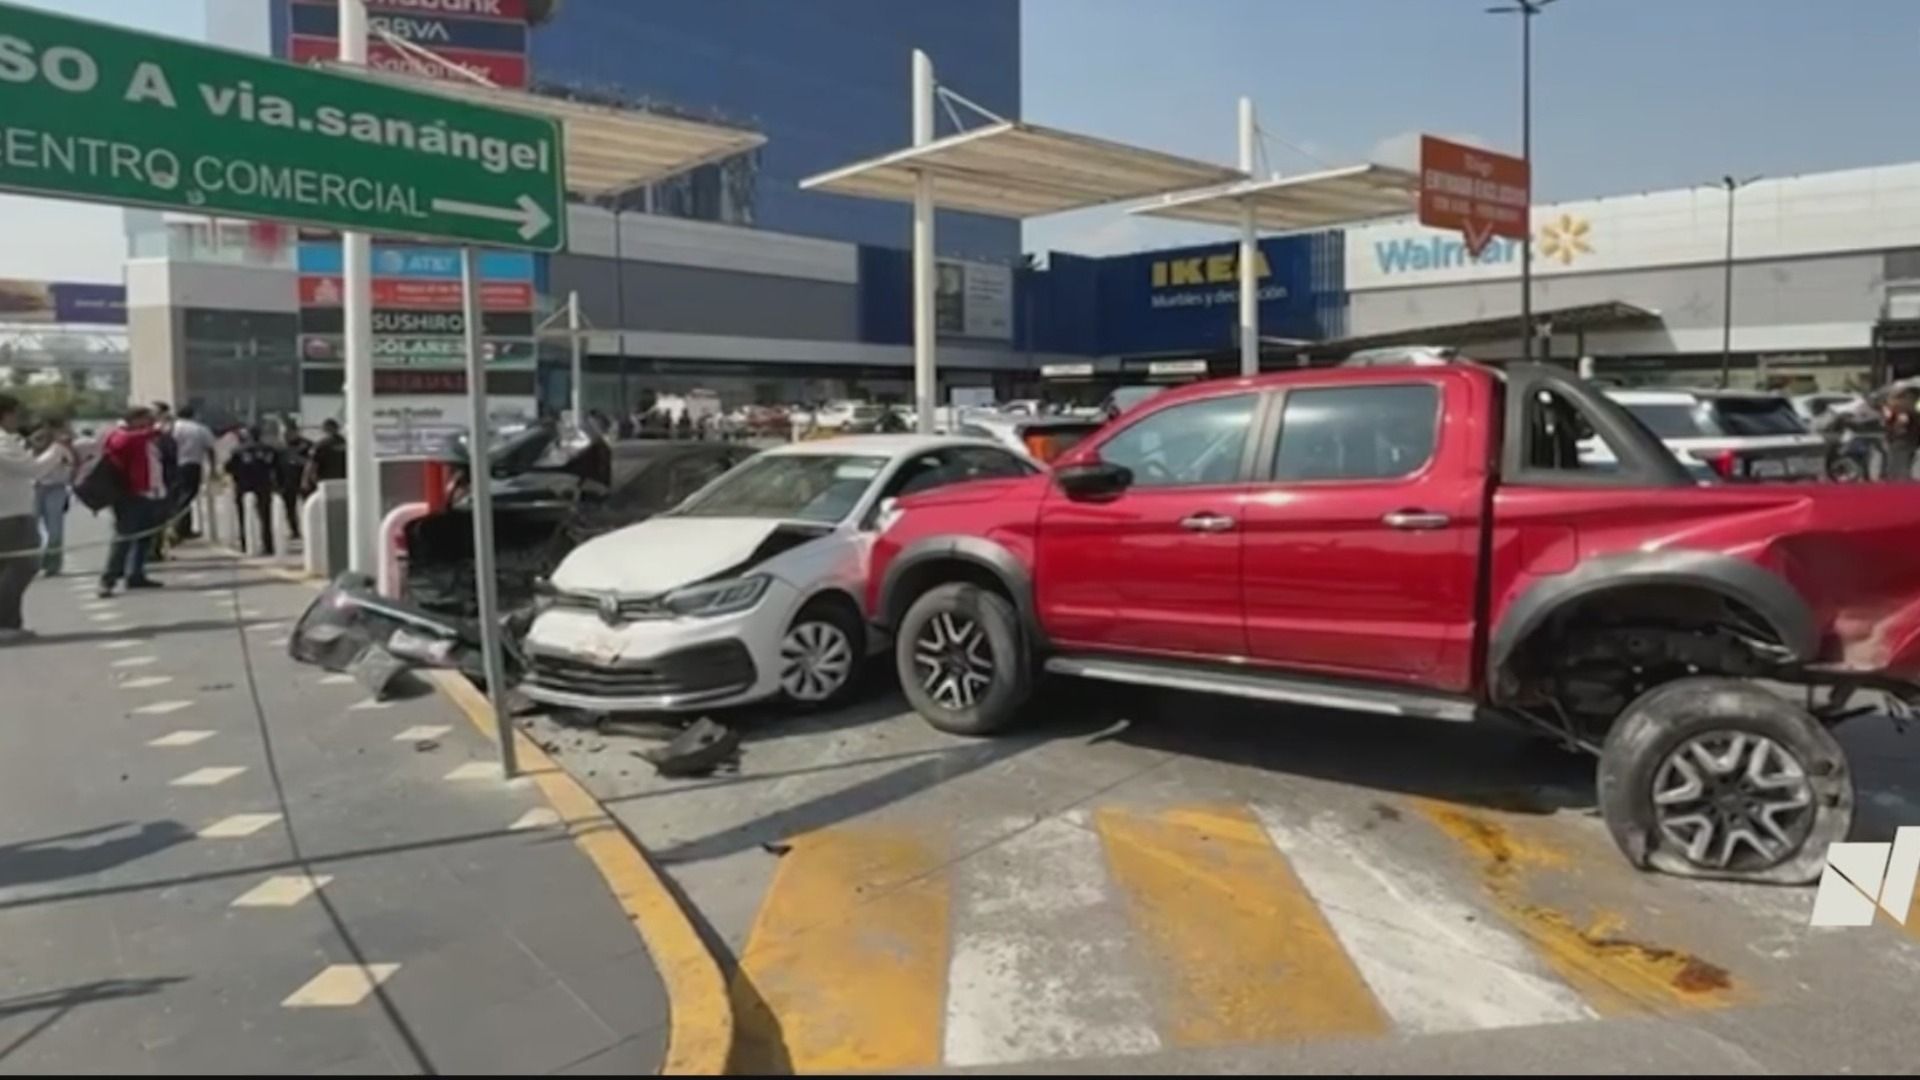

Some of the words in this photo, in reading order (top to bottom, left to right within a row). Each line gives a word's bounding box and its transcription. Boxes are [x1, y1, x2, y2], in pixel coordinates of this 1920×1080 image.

[124, 61, 177, 109] A
[0, 126, 180, 190] ENTRO
[193, 155, 429, 218] COMERCIAL
